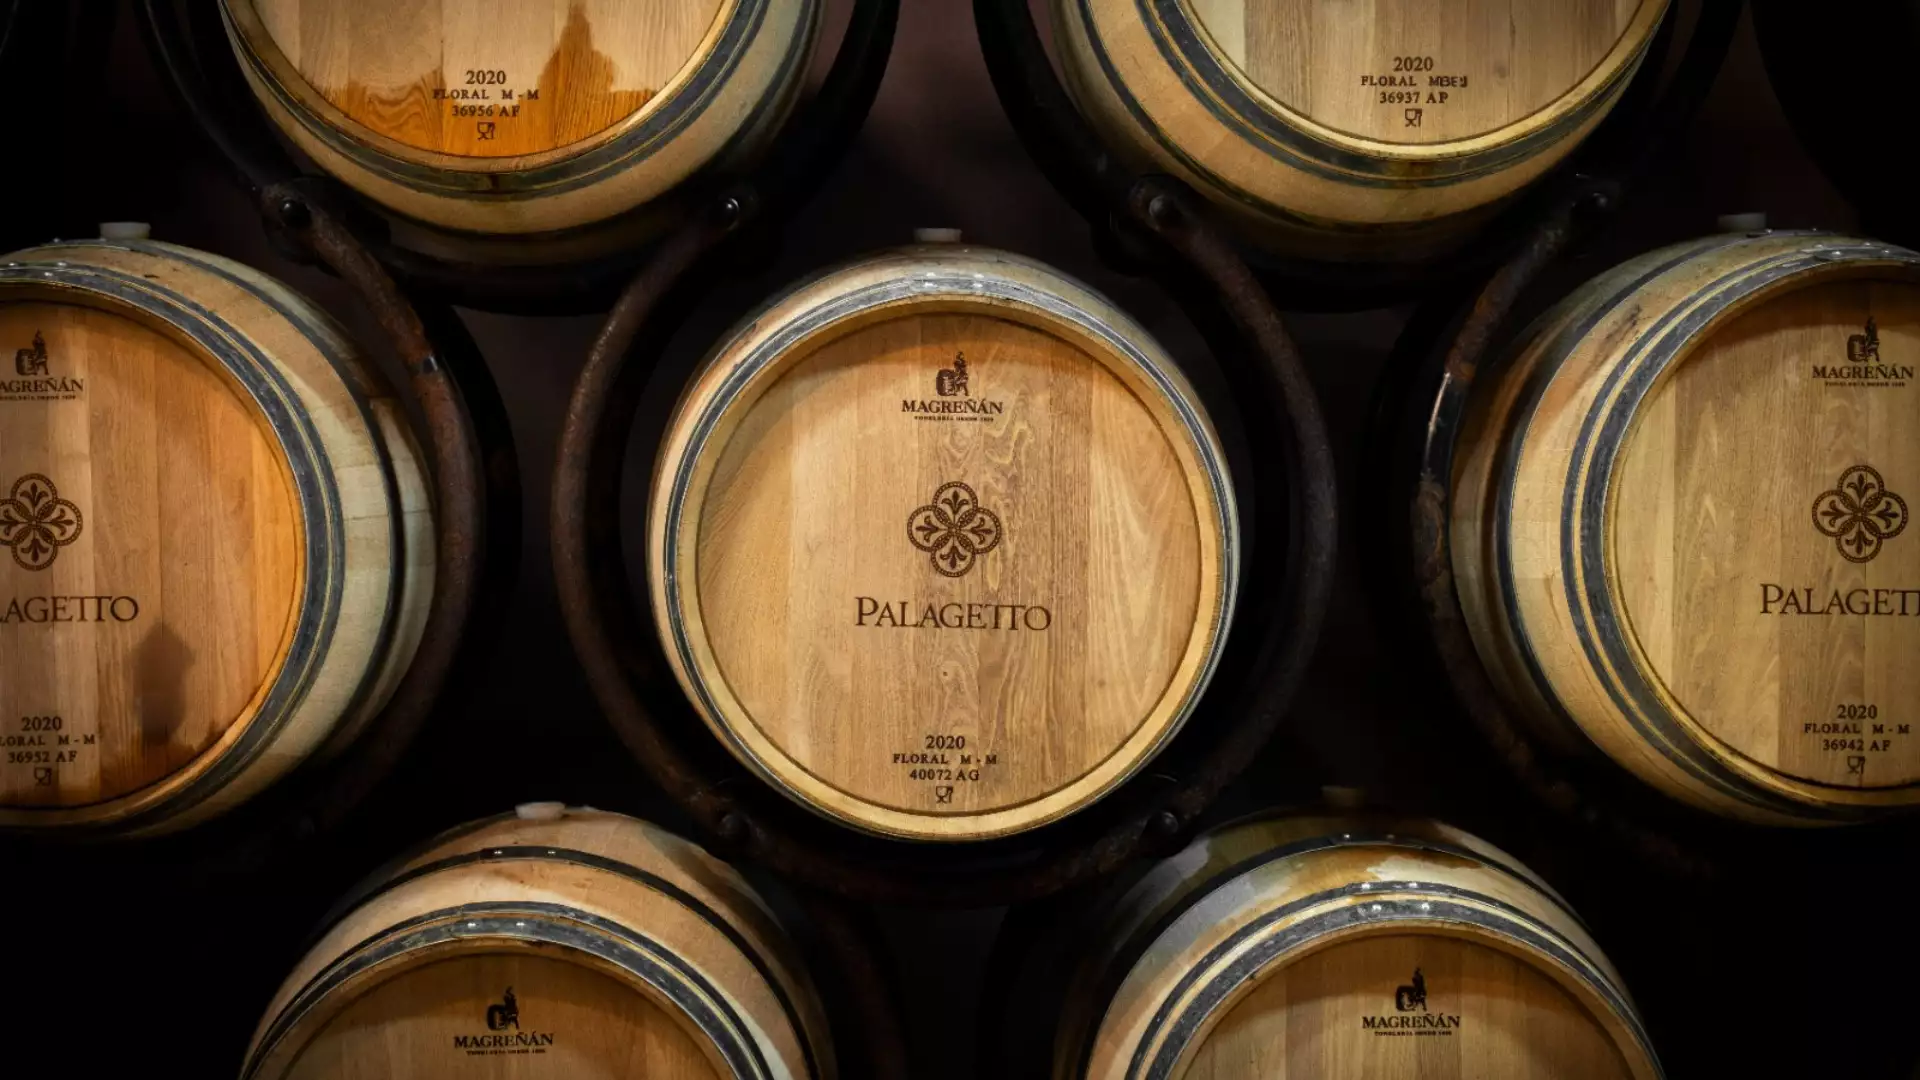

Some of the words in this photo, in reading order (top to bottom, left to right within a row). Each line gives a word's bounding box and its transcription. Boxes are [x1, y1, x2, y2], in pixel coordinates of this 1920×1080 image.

[1393, 56, 1434, 72] 2020
[465, 70, 507, 85] 2020
[1361, 75, 1417, 87] FLORAL
[432, 88, 490, 100] FLORAL
[1379, 92, 1420, 104] 36937
[452, 105, 493, 117] 36956
[1812, 362, 1914, 379] MAGREÑÁN
[0, 376, 84, 393] AGREÑÁN
[901, 398, 1003, 414] MAGREÑÁN
[854, 596, 1052, 631] PALAGETTO
[1837, 704, 1878, 719] 2020
[21, 716, 62, 731] 2020
[1804, 723, 1861, 734] FLORAL
[925, 735, 966, 749] 2020
[1822, 739, 1864, 751] 36942
[7, 751, 50, 763] 36952
[893, 753, 949, 764] FLORAL
[909, 769, 952, 781] 40072
[956, 770, 980, 781] AG
[1362, 1013, 1461, 1028] MAGREÑÁN
[454, 1031, 555, 1049] MAGREÑÁN
